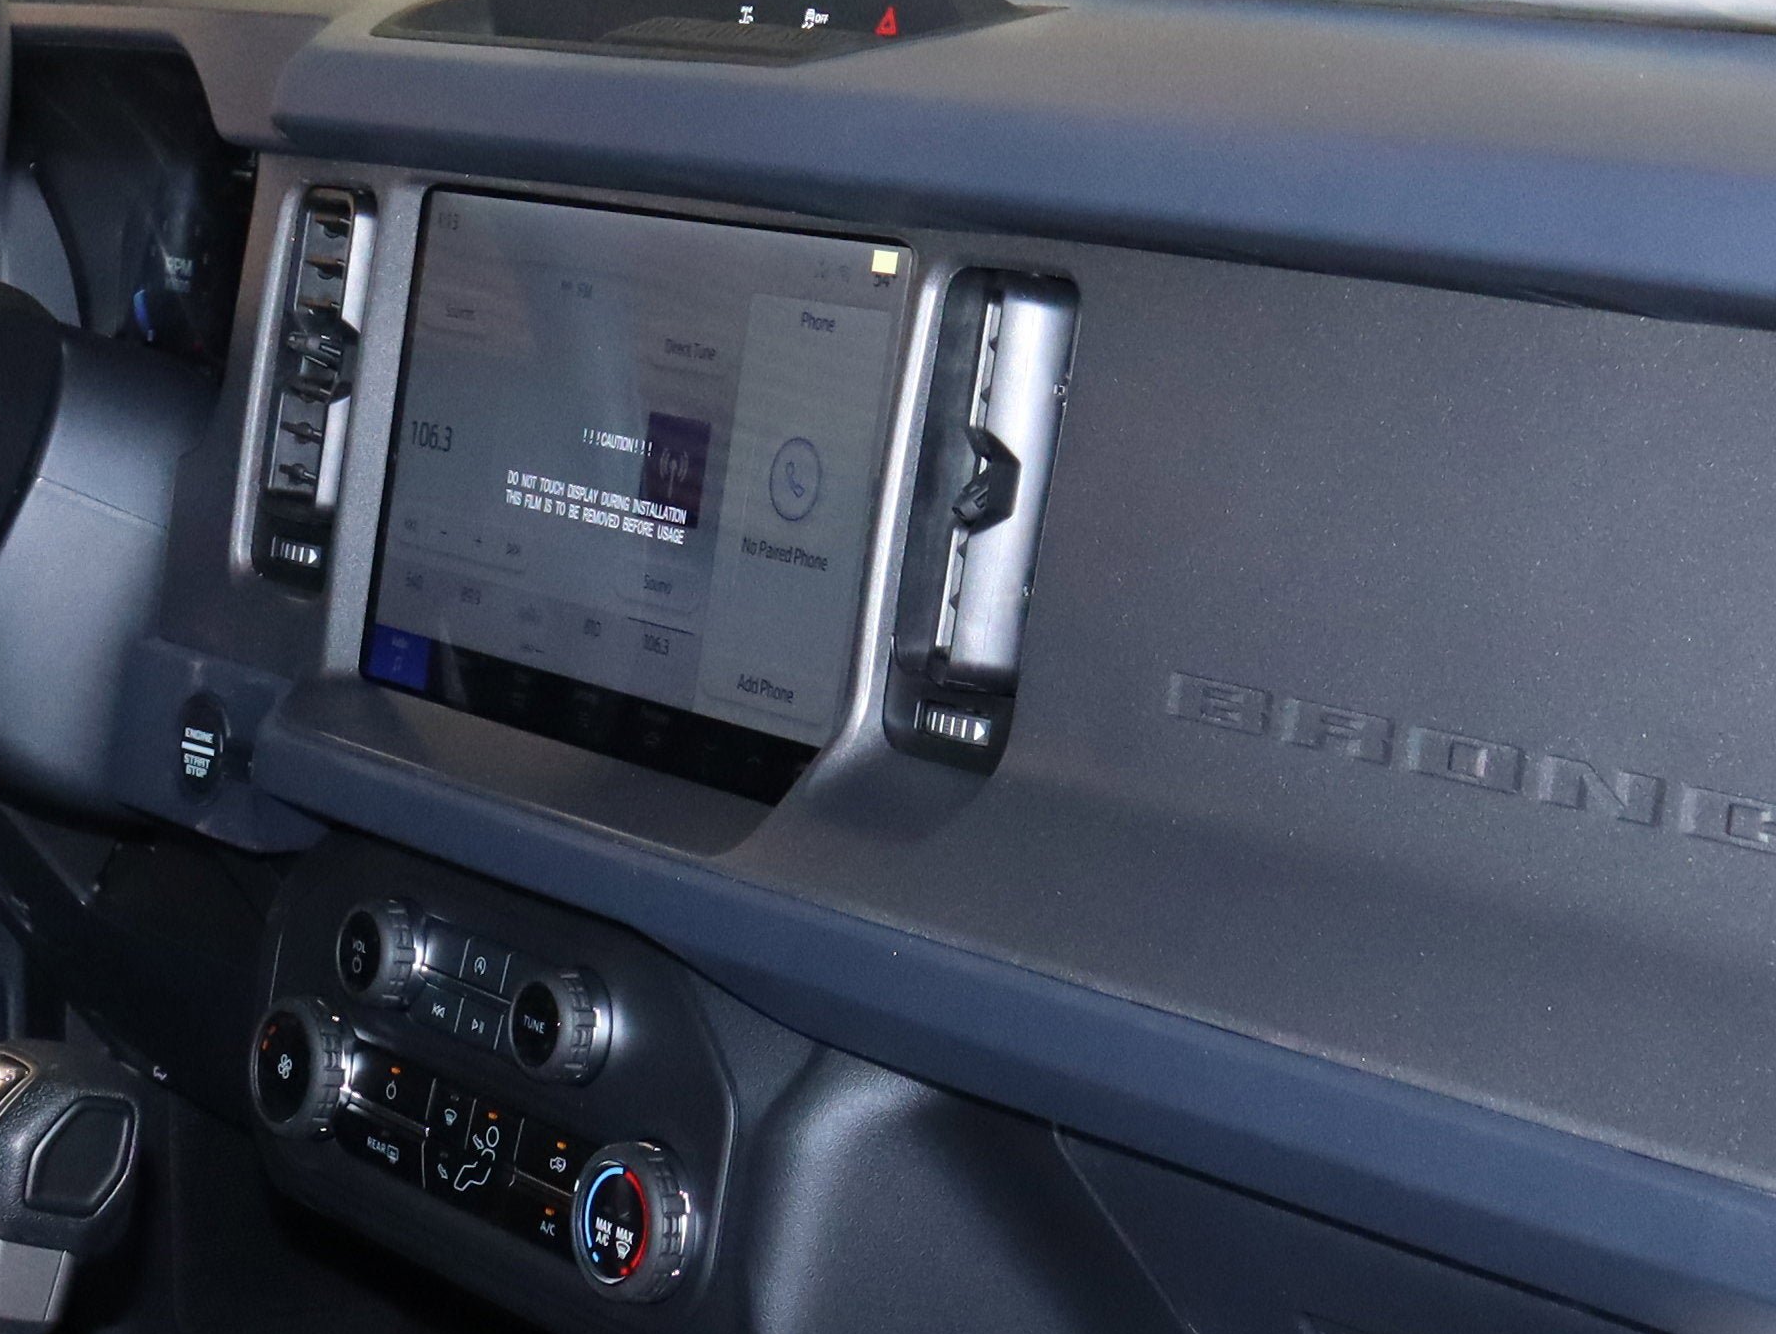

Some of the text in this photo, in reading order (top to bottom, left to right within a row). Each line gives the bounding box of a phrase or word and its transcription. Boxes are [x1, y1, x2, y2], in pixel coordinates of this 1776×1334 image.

[815, 13, 829, 25] OFF
[801, 311, 836, 333] Phone
[410, 420, 453, 452] 106.3
[507, 469, 687, 525] DO NOT TOUCH DISPLAY DURING INSTALLATION
[506, 489, 686, 545] THIS FILM IS TO BE REMOVED BEFORE USAGE
[741, 536, 829, 571] No Paired Phone
[737, 673, 794, 704] Add Phone
[184, 753, 211, 769] START
[185, 763, 208, 779] STOP
[352, 937, 367, 955] VOL
[523, 1015, 545, 1035] TUNE
[367, 1135, 387, 1155] REAR
[539, 1219, 556, 1237] A/C
[595, 1216, 613, 1235] MAX
[595, 1231, 610, 1247] A/C
[615, 1226, 634, 1245] MAX
